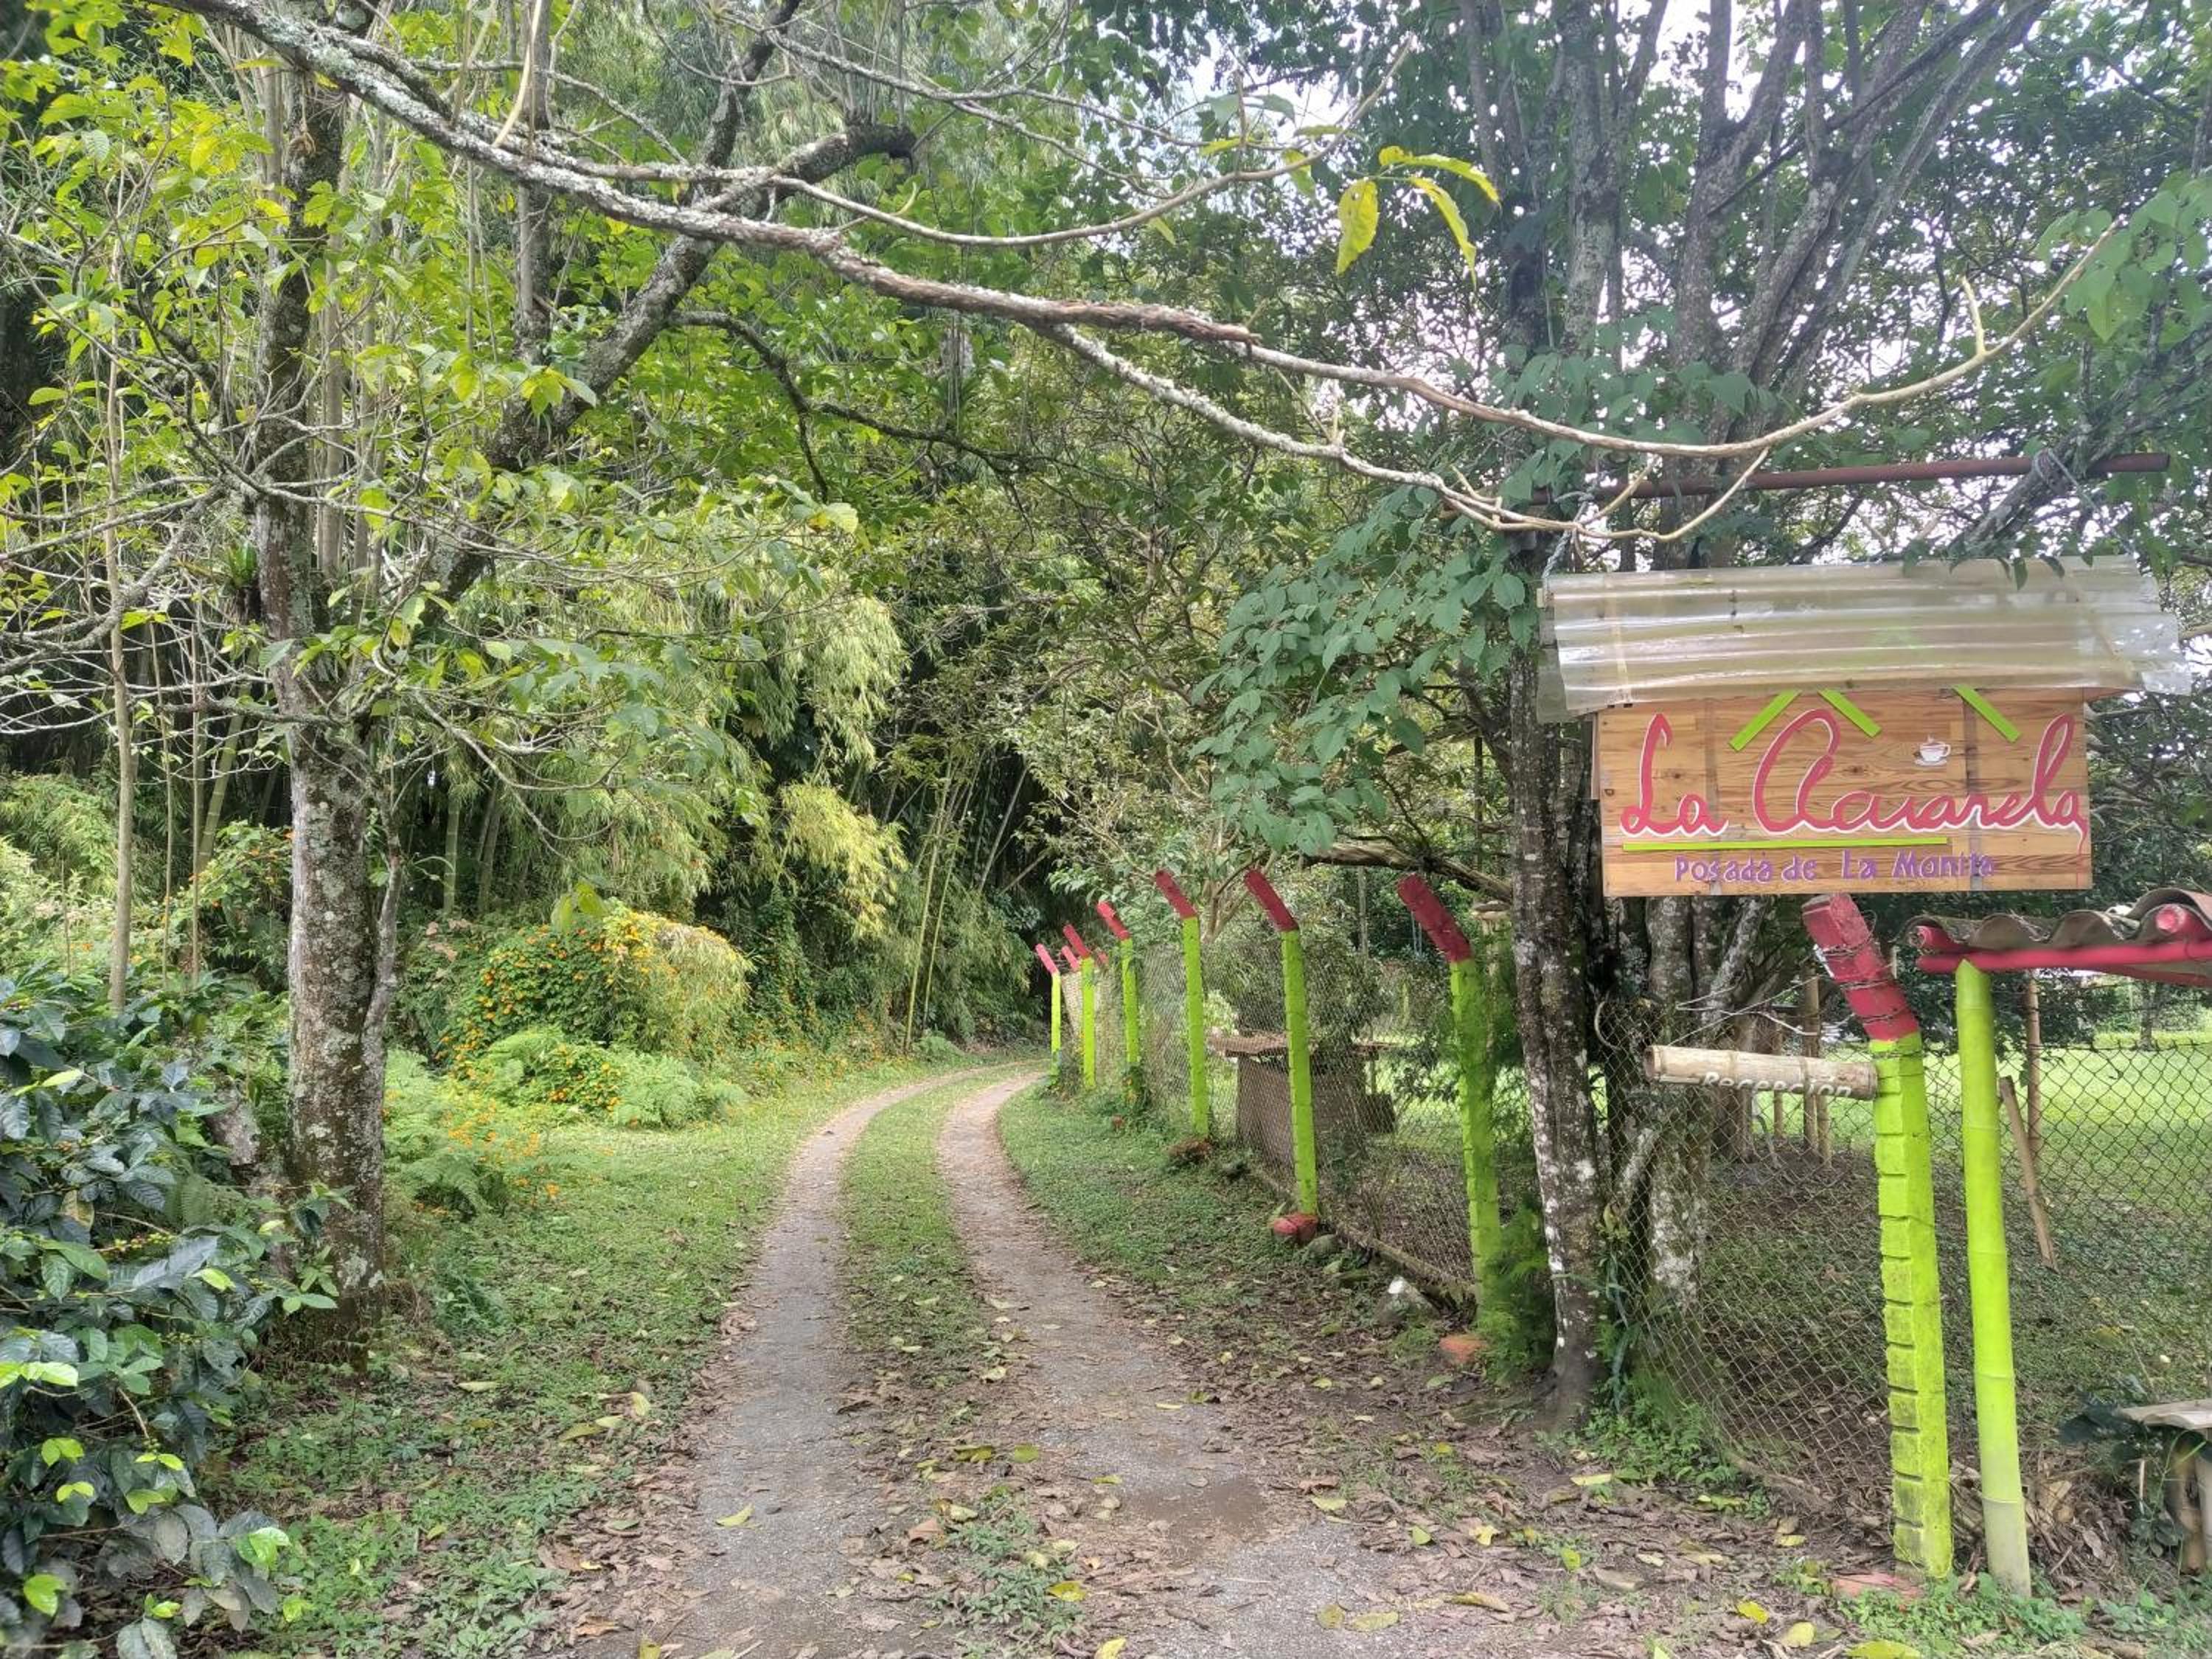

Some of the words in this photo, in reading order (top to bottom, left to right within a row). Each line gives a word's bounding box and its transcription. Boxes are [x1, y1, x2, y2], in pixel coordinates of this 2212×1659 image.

[1619, 713, 1729, 838] La
[1753, 709, 2088, 855] Acuarela
[1674, 854, 1773, 884] Posada
[1781, 853, 1818, 883] de
[1840, 849, 1877, 881] La
